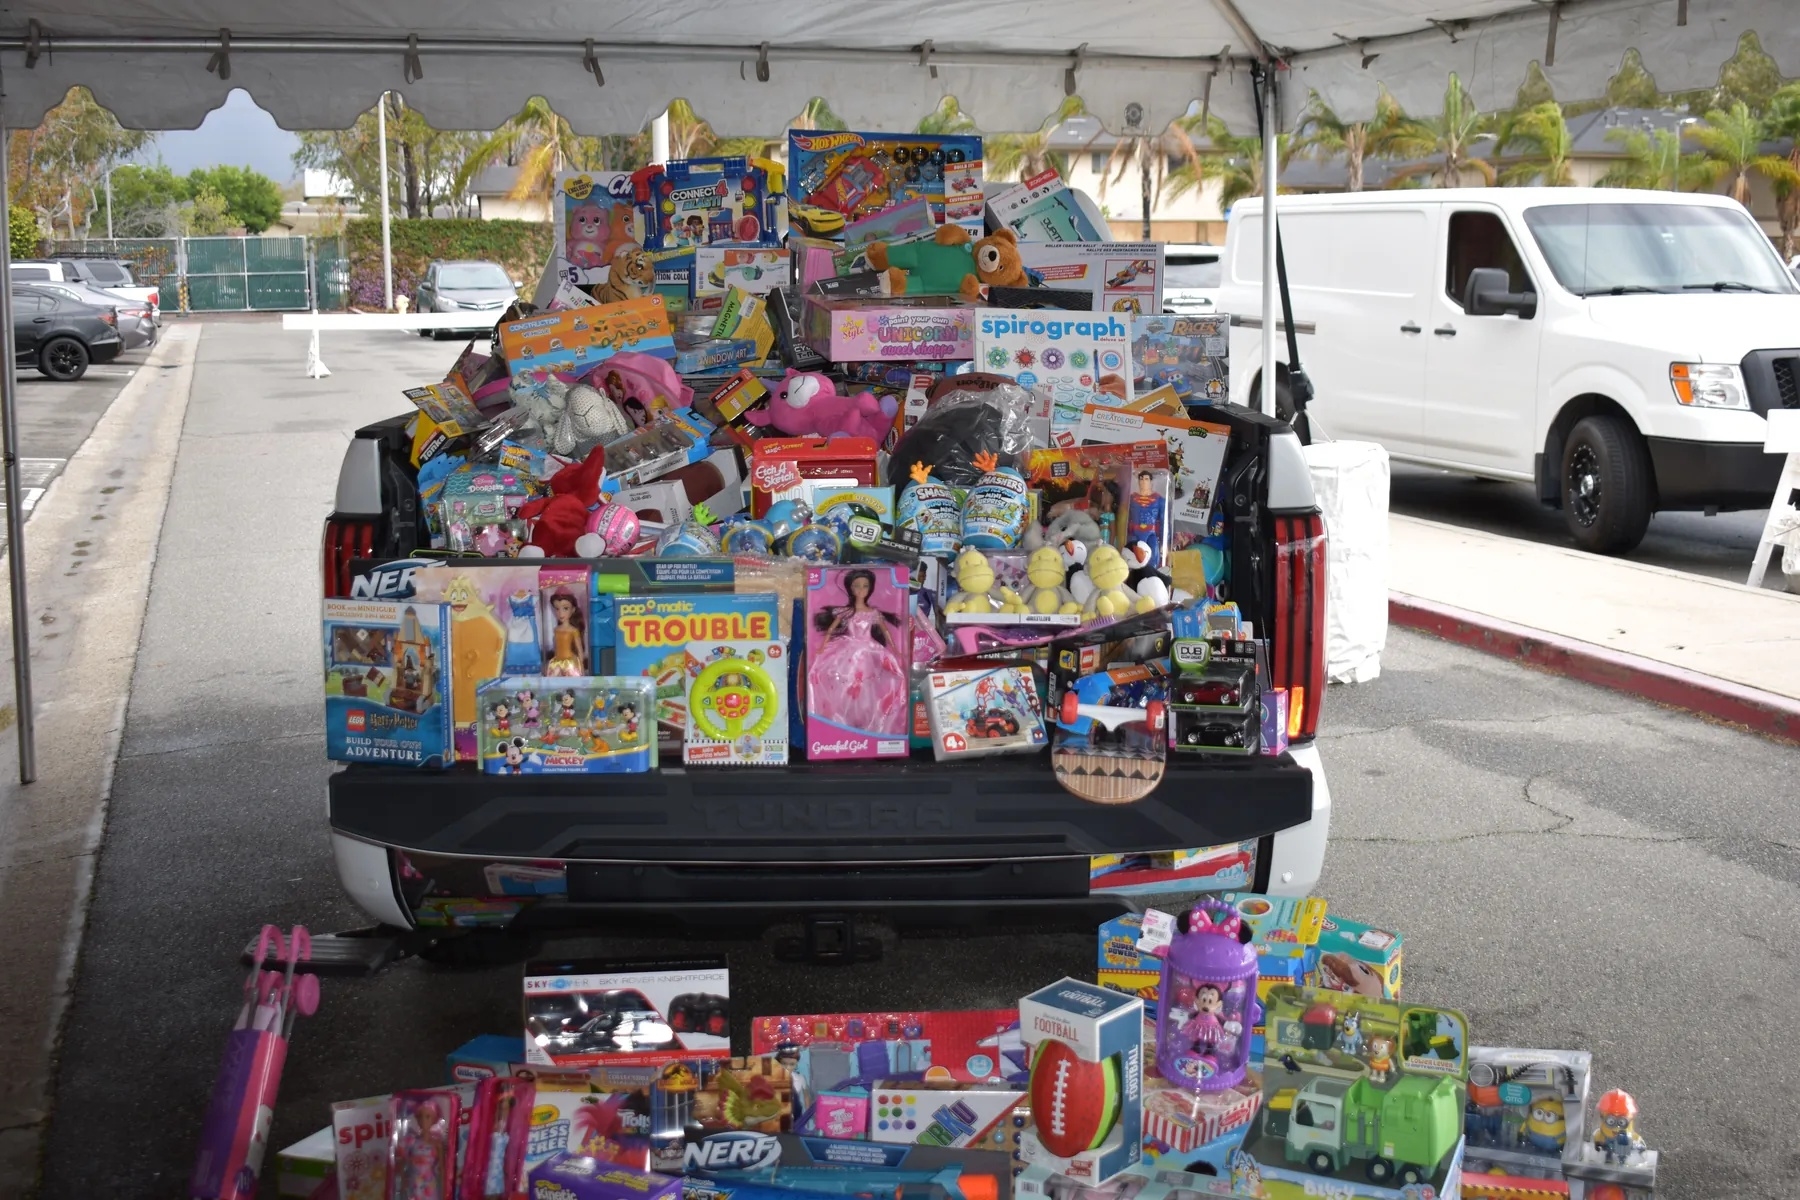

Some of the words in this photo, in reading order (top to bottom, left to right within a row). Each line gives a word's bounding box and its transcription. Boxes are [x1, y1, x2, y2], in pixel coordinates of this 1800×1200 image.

[811, 138, 831, 150] HOT
[671, 187, 716, 200] CONNECT
[716, 180, 728, 197] 4
[568, 267, 579, 283] 5
[656, 271, 671, 280] TION
[508, 317, 561, 332] CONSTRUCTION
[889, 315, 908, 326] paint
[911, 316, 930, 326] your
[932, 316, 949, 325] own
[982, 314, 1125, 341] spirograph
[878, 326, 959, 343] UNICORN
[699, 352, 734, 365] WINDOW
[735, 348, 747, 360] ART
[881, 343, 914, 356] sweet
[914, 342, 955, 358] shoppe
[727, 379, 740, 391] MAN
[1096, 412, 1140, 425] CREATOLOGY
[419, 435, 446, 461] Tonka
[755, 465, 777, 479] Etch
[776, 462, 788, 475] A
[763, 474, 795, 488] Sketch
[978, 474, 1023, 494] SMASHERS
[1200, 511, 1205, 519] 1
[855, 525, 875, 537] DUB
[327, 603, 346, 611] BOOK
[357, 605, 396, 613] MINIFIGURE
[620, 603, 645, 615] pop
[622, 614, 769, 646] TROUBLE
[1180, 647, 1202, 655] DUB
[348, 716, 365, 724] LEGO
[370, 713, 394, 731] Harry
[393, 712, 419, 730] Potter
[345, 736, 372, 745] BUILD
[812, 741, 849, 755] Graceful
[848, 739, 868, 754] Girl
[946, 735, 965, 749] 4+
[345, 746, 423, 761] ADVENTURE
[544, 755, 585, 766] MICKEY
[692, 802, 955, 831] TUNDRA
[1108, 947, 1138, 958] POWERS
[1111, 942, 1134, 951] SUPER
[599, 976, 619, 985] SKY
[621, 975, 656, 984] ROVER
[657, 973, 725, 983] KNIGHTFORCE
[1058, 989, 1107, 1008] FOOTBALL
[1034, 1015, 1079, 1042] FOOTBALL
[1410, 1057, 1433, 1066] LOWER
[1433, 1059, 1454, 1068] LEVER
[1128, 1044, 1139, 1102] FOOTBALL
[618, 1109, 650, 1128] Trolls
[530, 1125, 569, 1142] MESS
[528, 1137, 569, 1155] FREE
[683, 1137, 777, 1170] NERF
